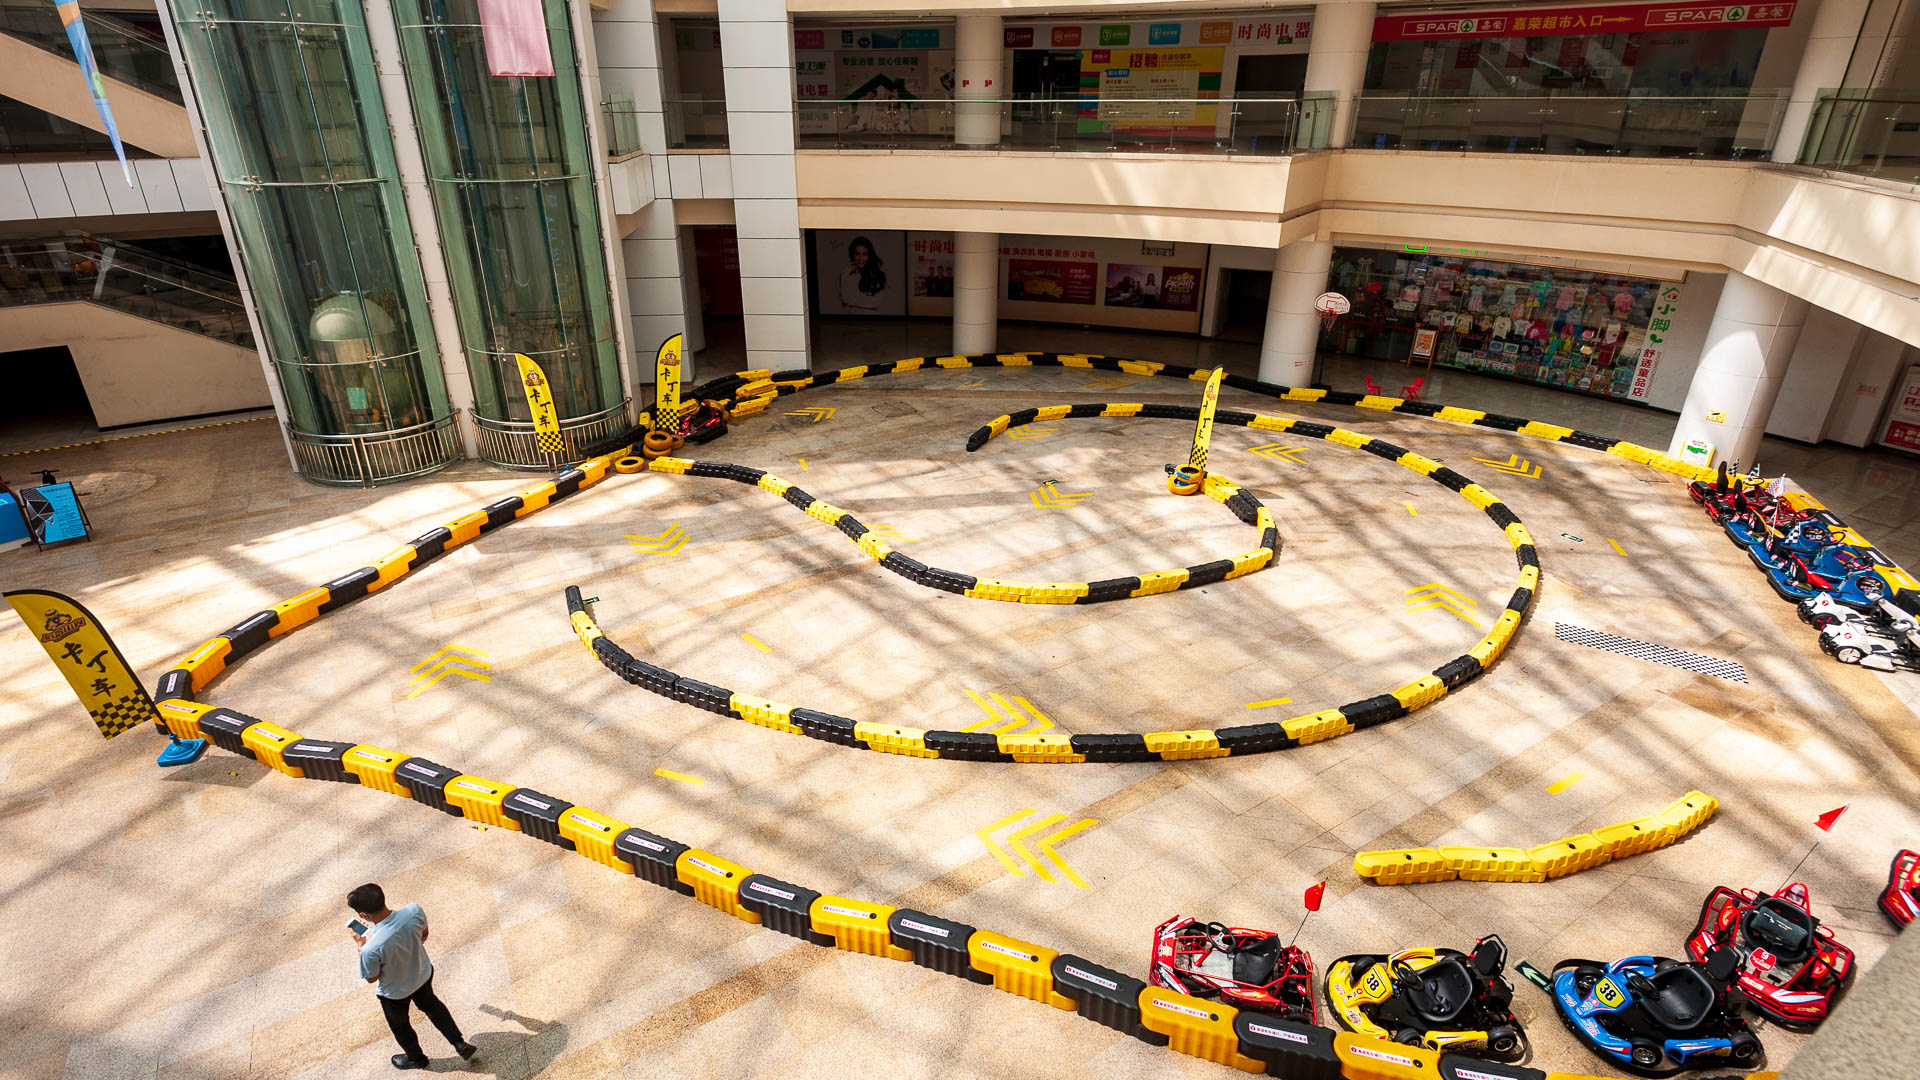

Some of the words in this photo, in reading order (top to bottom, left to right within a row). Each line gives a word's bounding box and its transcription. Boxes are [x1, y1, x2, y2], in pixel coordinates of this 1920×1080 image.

[1512, 15, 1603, 31] 嘉荣超市入口
[1664, 9, 1722, 22] SPAR
[1238, 21, 1310, 40] 时尚电器
[1416, 22, 1458, 33] SPAR
[842, 57, 874, 66] 专业治理
[1130, 53, 1159, 68] 招聘
[1013, 248, 1035, 257] 洗衣机
[1072, 250, 1096, 259] 小家电
[1632, 348, 1656, 397] 舒适童品店
[659, 367, 679, 407] 卡丁车
[529, 388, 552, 429] 卡丁车
[60, 641, 117, 698] 卡丁车
[1366, 973, 1380, 991] 38
[1599, 982, 1617, 1002] 38
